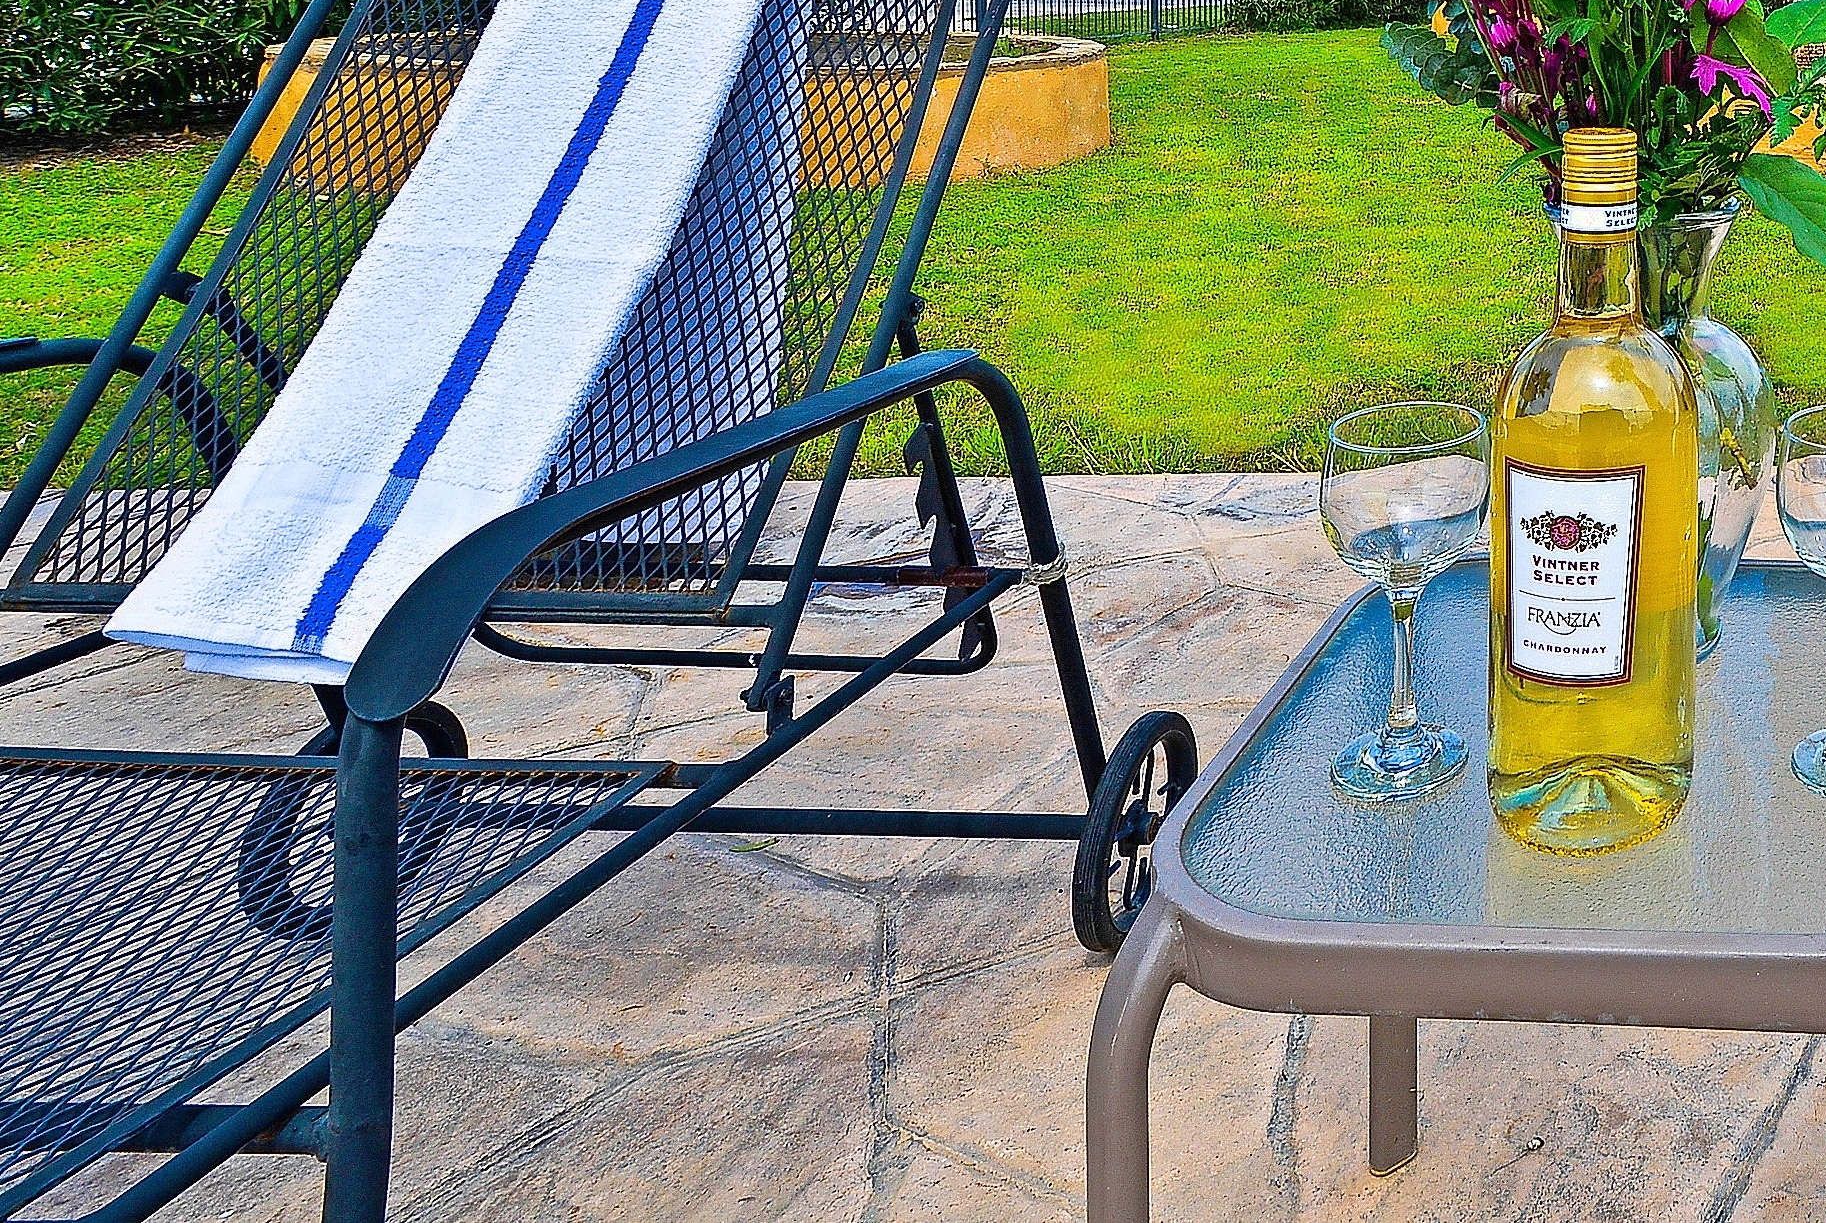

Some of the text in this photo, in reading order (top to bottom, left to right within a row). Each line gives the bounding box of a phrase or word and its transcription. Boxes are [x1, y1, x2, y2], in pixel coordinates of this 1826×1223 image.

[1532, 554, 1600, 571] VINTNER
[1533, 570, 1598, 585] SELECT
[1527, 606, 1601, 636] FRANZIA
[1523, 639, 1607, 654] CHARDONNAY
